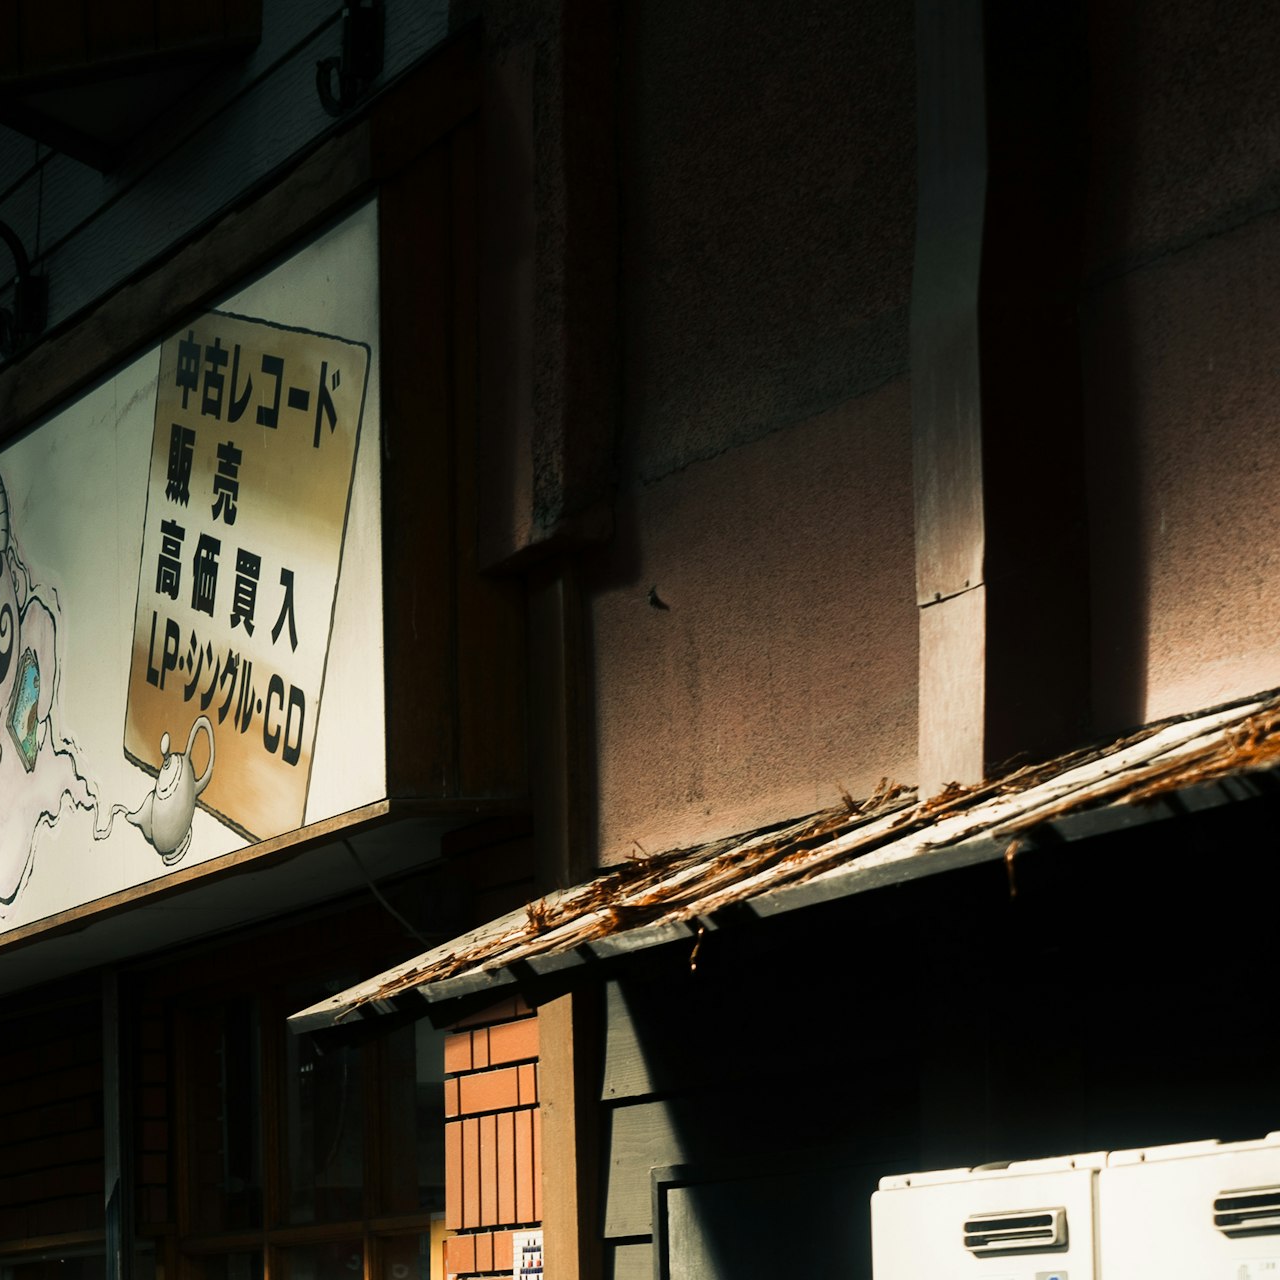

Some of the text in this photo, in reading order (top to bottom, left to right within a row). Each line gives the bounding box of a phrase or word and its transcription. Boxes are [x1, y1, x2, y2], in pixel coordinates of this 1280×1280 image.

[175, 330, 340, 449] 中古レコード
[165, 423, 243, 526] 販売
[155, 519, 299, 654] 高価買入
